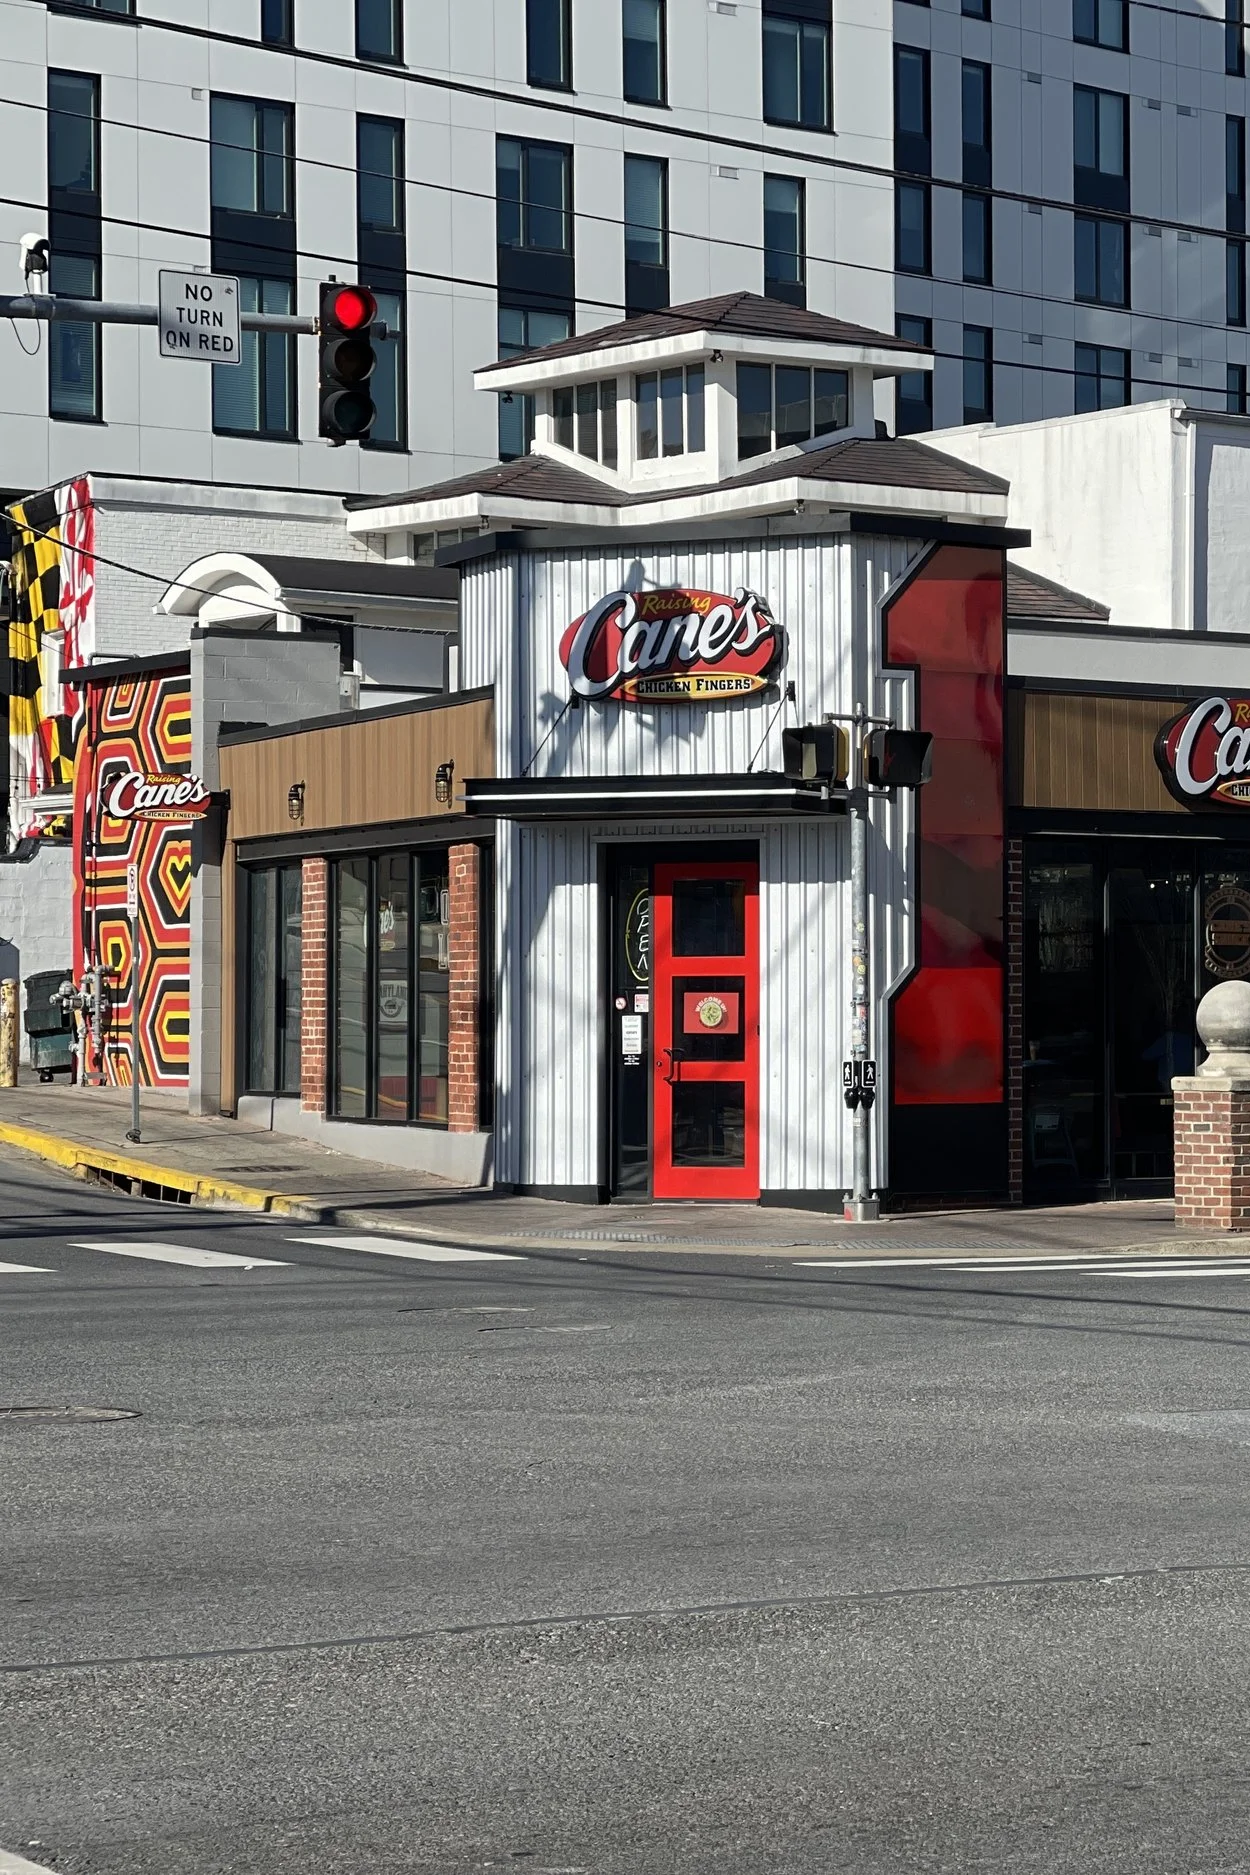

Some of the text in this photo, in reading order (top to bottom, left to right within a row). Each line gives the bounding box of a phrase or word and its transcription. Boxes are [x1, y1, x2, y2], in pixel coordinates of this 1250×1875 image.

[185, 283, 213, 302] NO
[176, 306, 223, 327] TURN
[166, 330, 234, 352] ON RED
[641, 594, 711, 616] Raising
[567, 587, 773, 697] Cane's
[637, 677, 751, 694] CHICKEN FINGERS
[146, 774, 182, 785] Raising
[108, 771, 211, 818] Cane's
